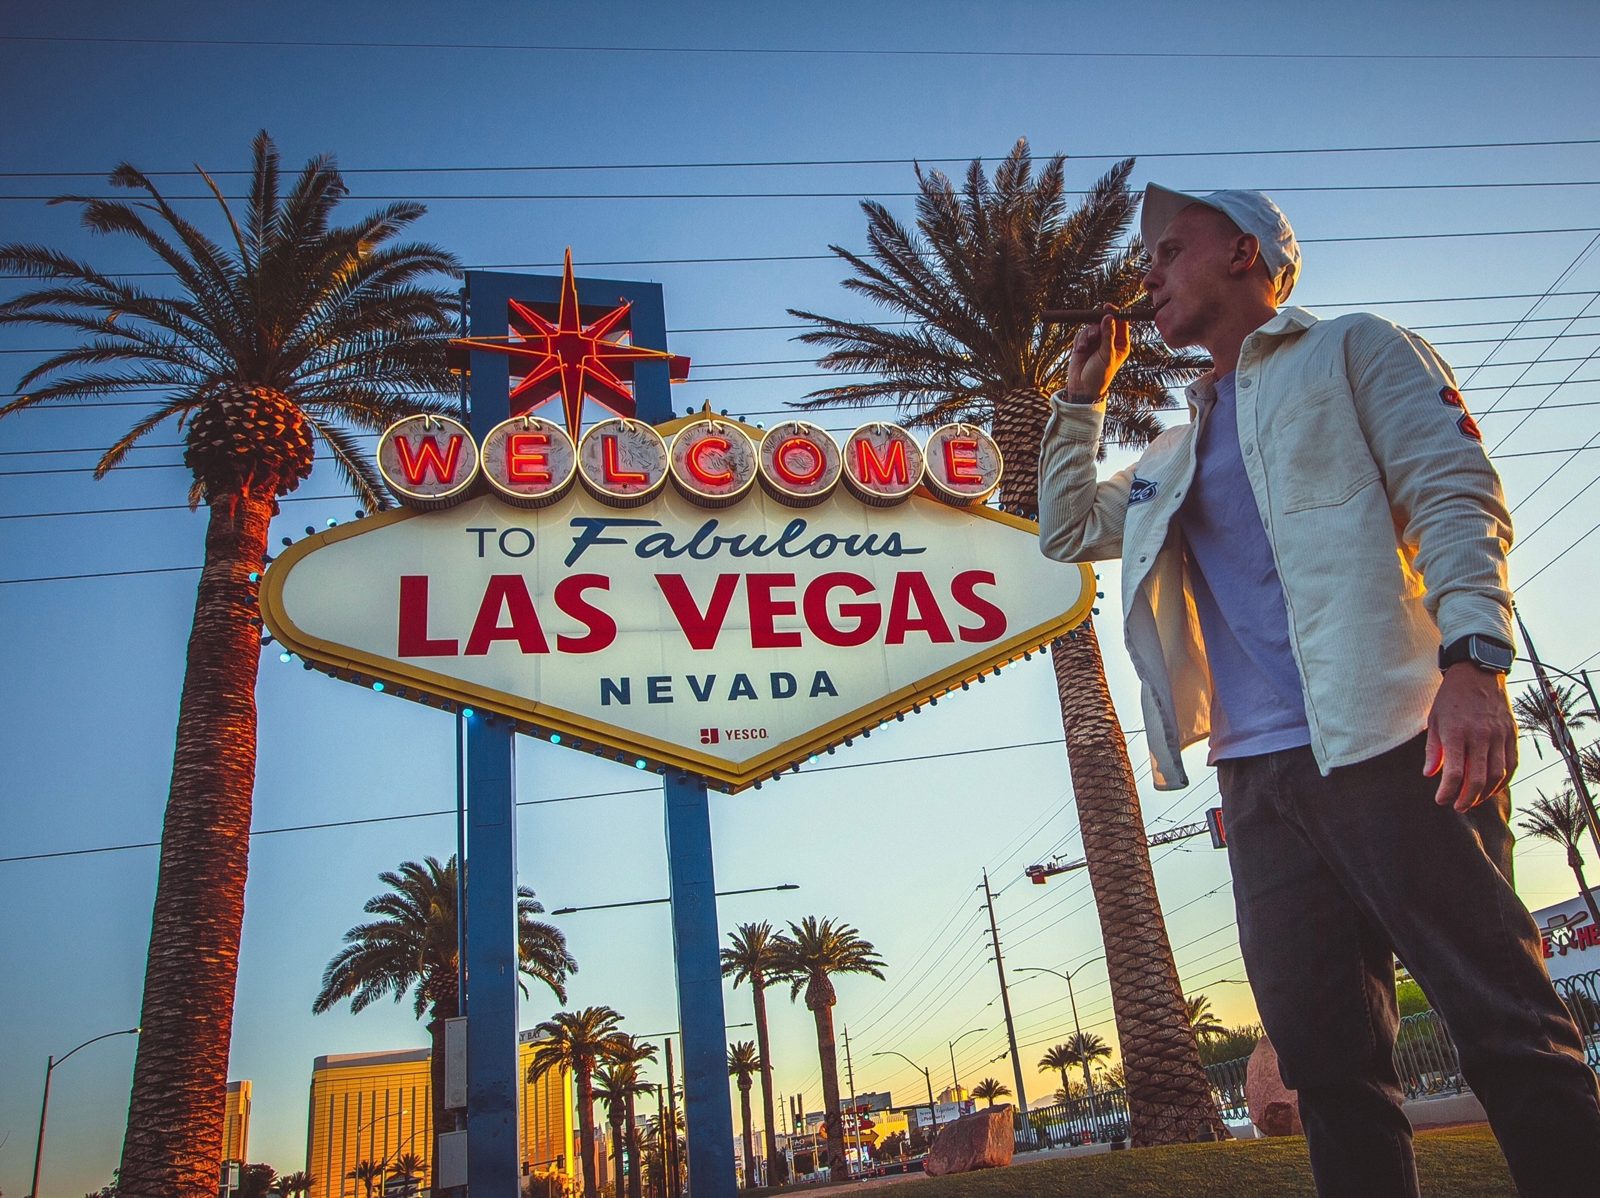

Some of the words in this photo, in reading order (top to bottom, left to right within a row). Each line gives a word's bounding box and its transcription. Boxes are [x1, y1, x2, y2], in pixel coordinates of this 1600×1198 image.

[398, 433, 983, 486] WELCOME
[465, 527, 536, 558] TO
[562, 517, 928, 568] Fabulous
[399, 573, 618, 658] LAS
[655, 570, 1008, 651] VEGAS
[600, 670, 840, 706] NEVADA
[725, 728, 767, 741] YESCO
